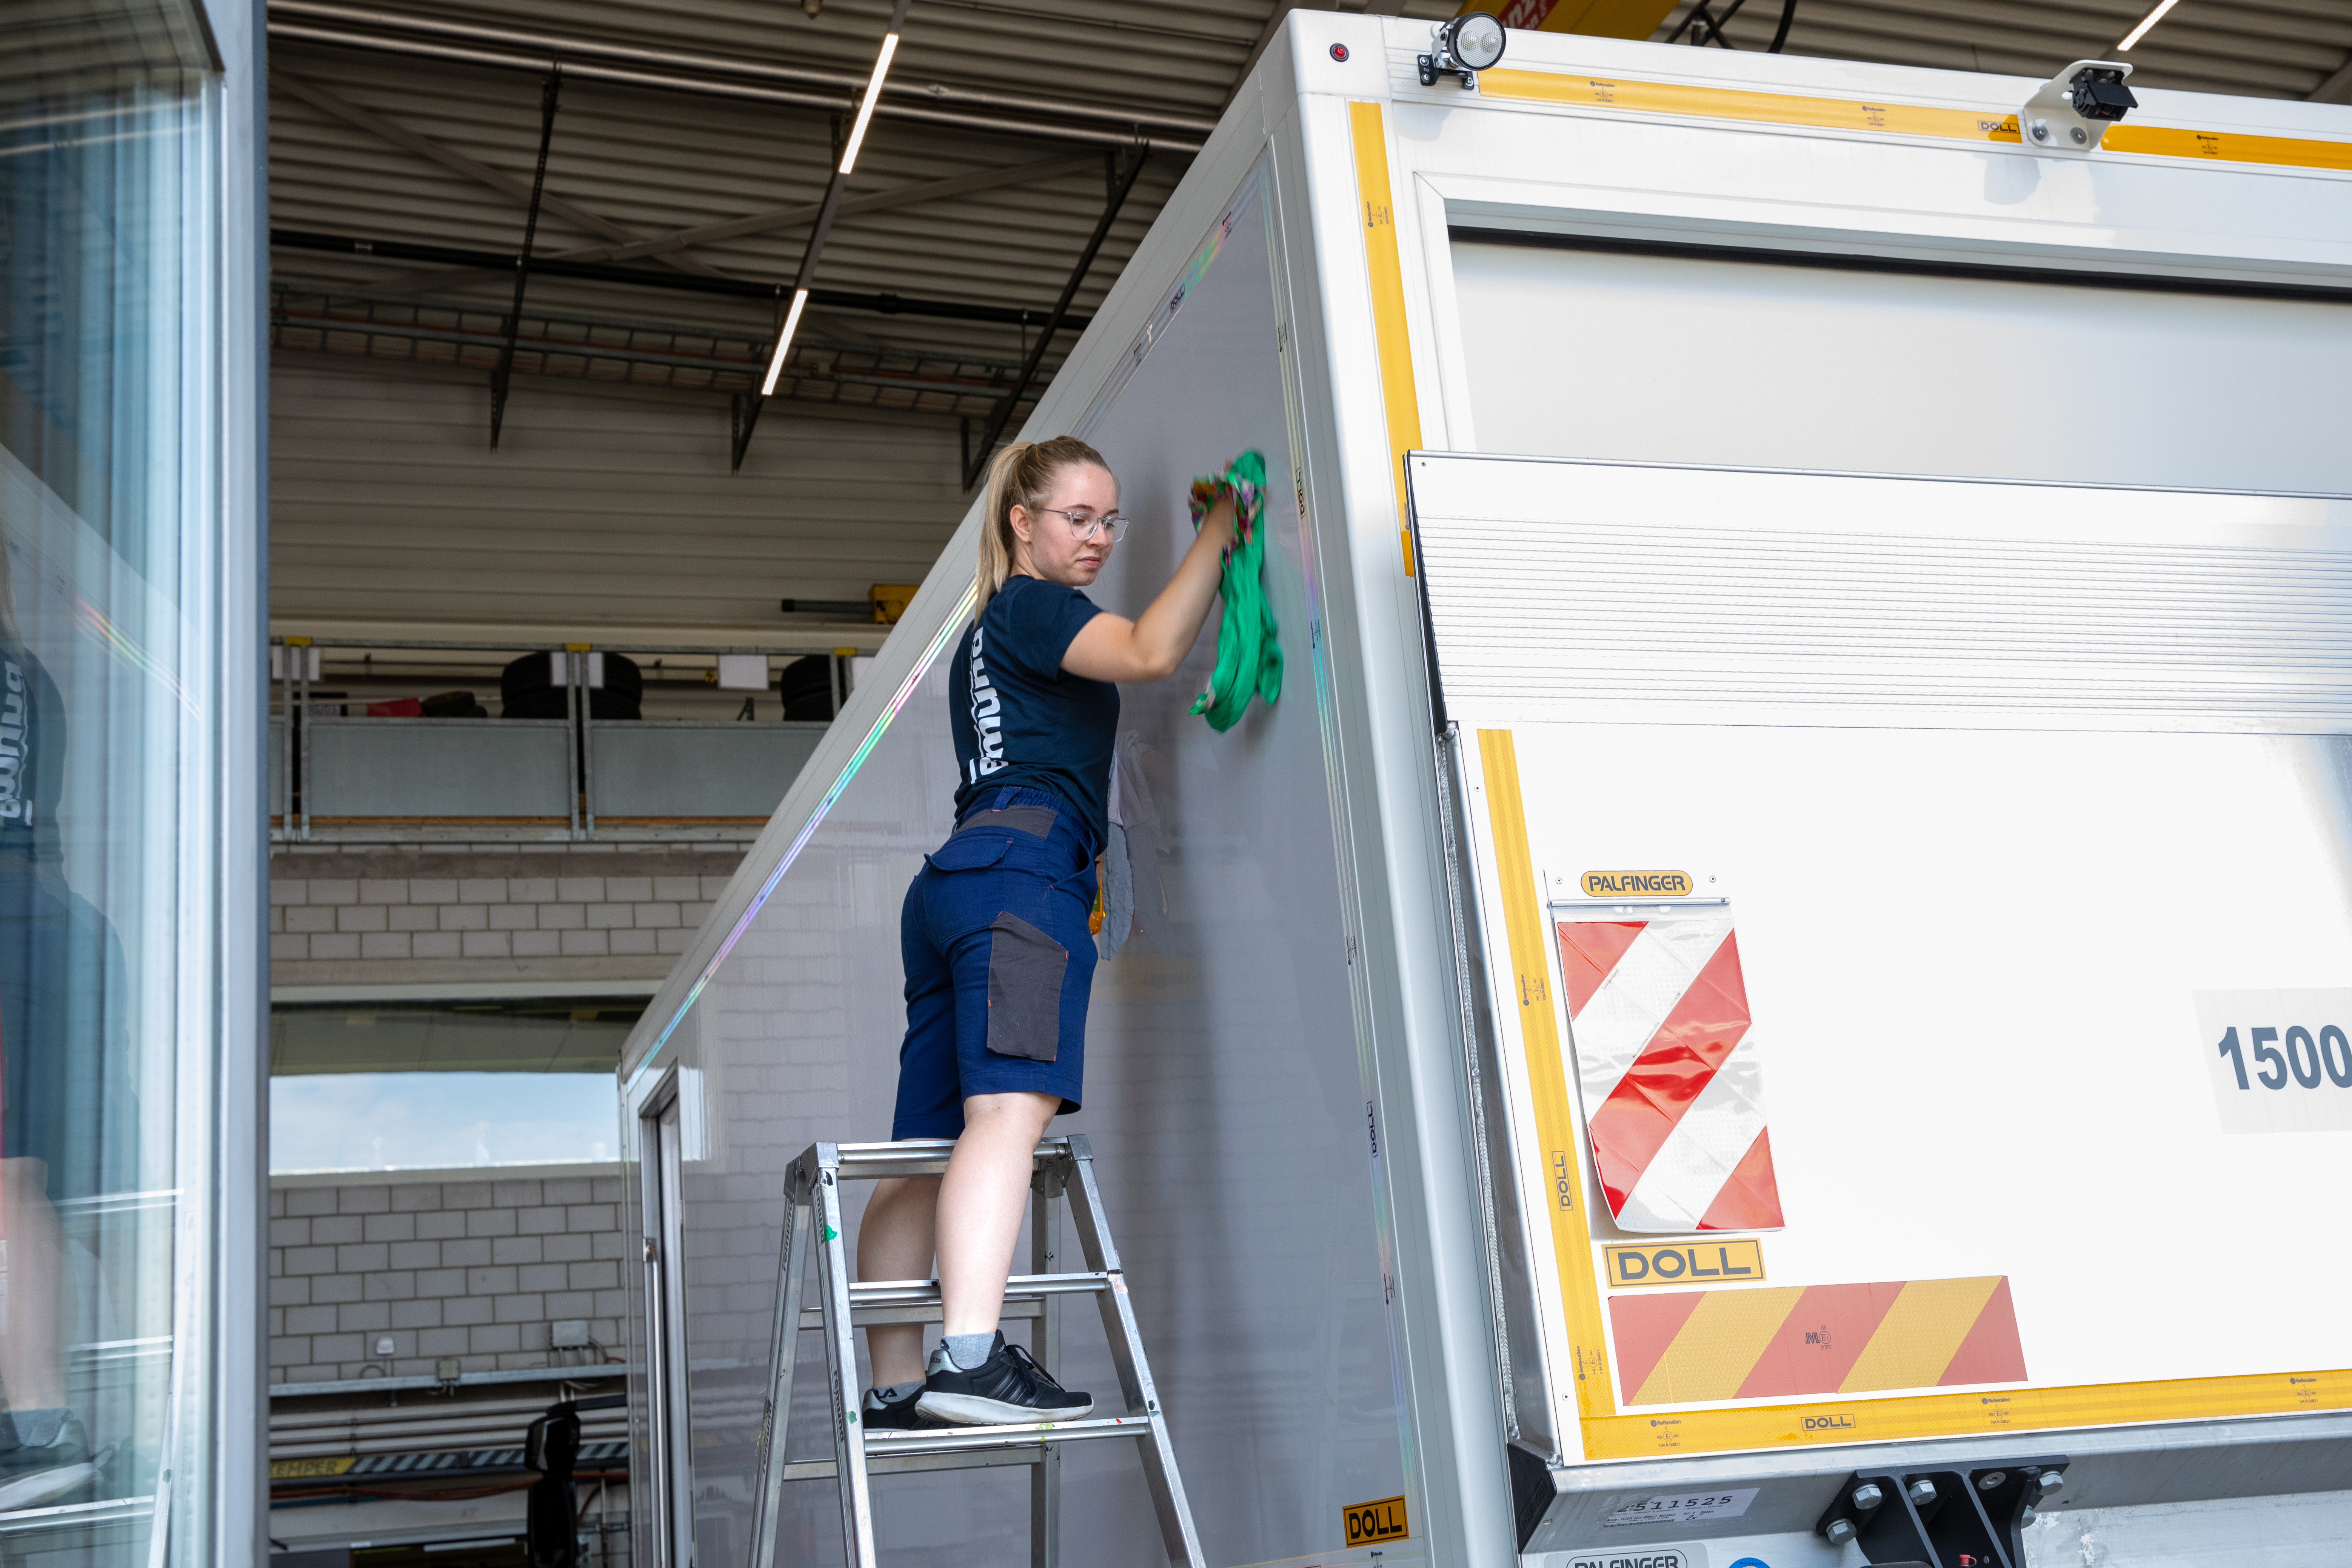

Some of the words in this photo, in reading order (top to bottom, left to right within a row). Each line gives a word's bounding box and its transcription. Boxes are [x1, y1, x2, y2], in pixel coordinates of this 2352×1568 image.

[1981, 122, 2016, 132] DOLL
[1171, 289, 1184, 310] DOLL
[973, 627, 1009, 775] emund
[1589, 876, 1686, 891] PALFINGER
[2218, 1025, 2352, 1090] 1500
[1556, 1156, 1570, 1206] DOLL
[1618, 1247, 1751, 1280] DOLL
[1805, 1416, 1851, 1429] DOLL
[1520, 1481, 1547, 1529] PALFINGER
[1349, 1506, 1402, 1539] DOLL
